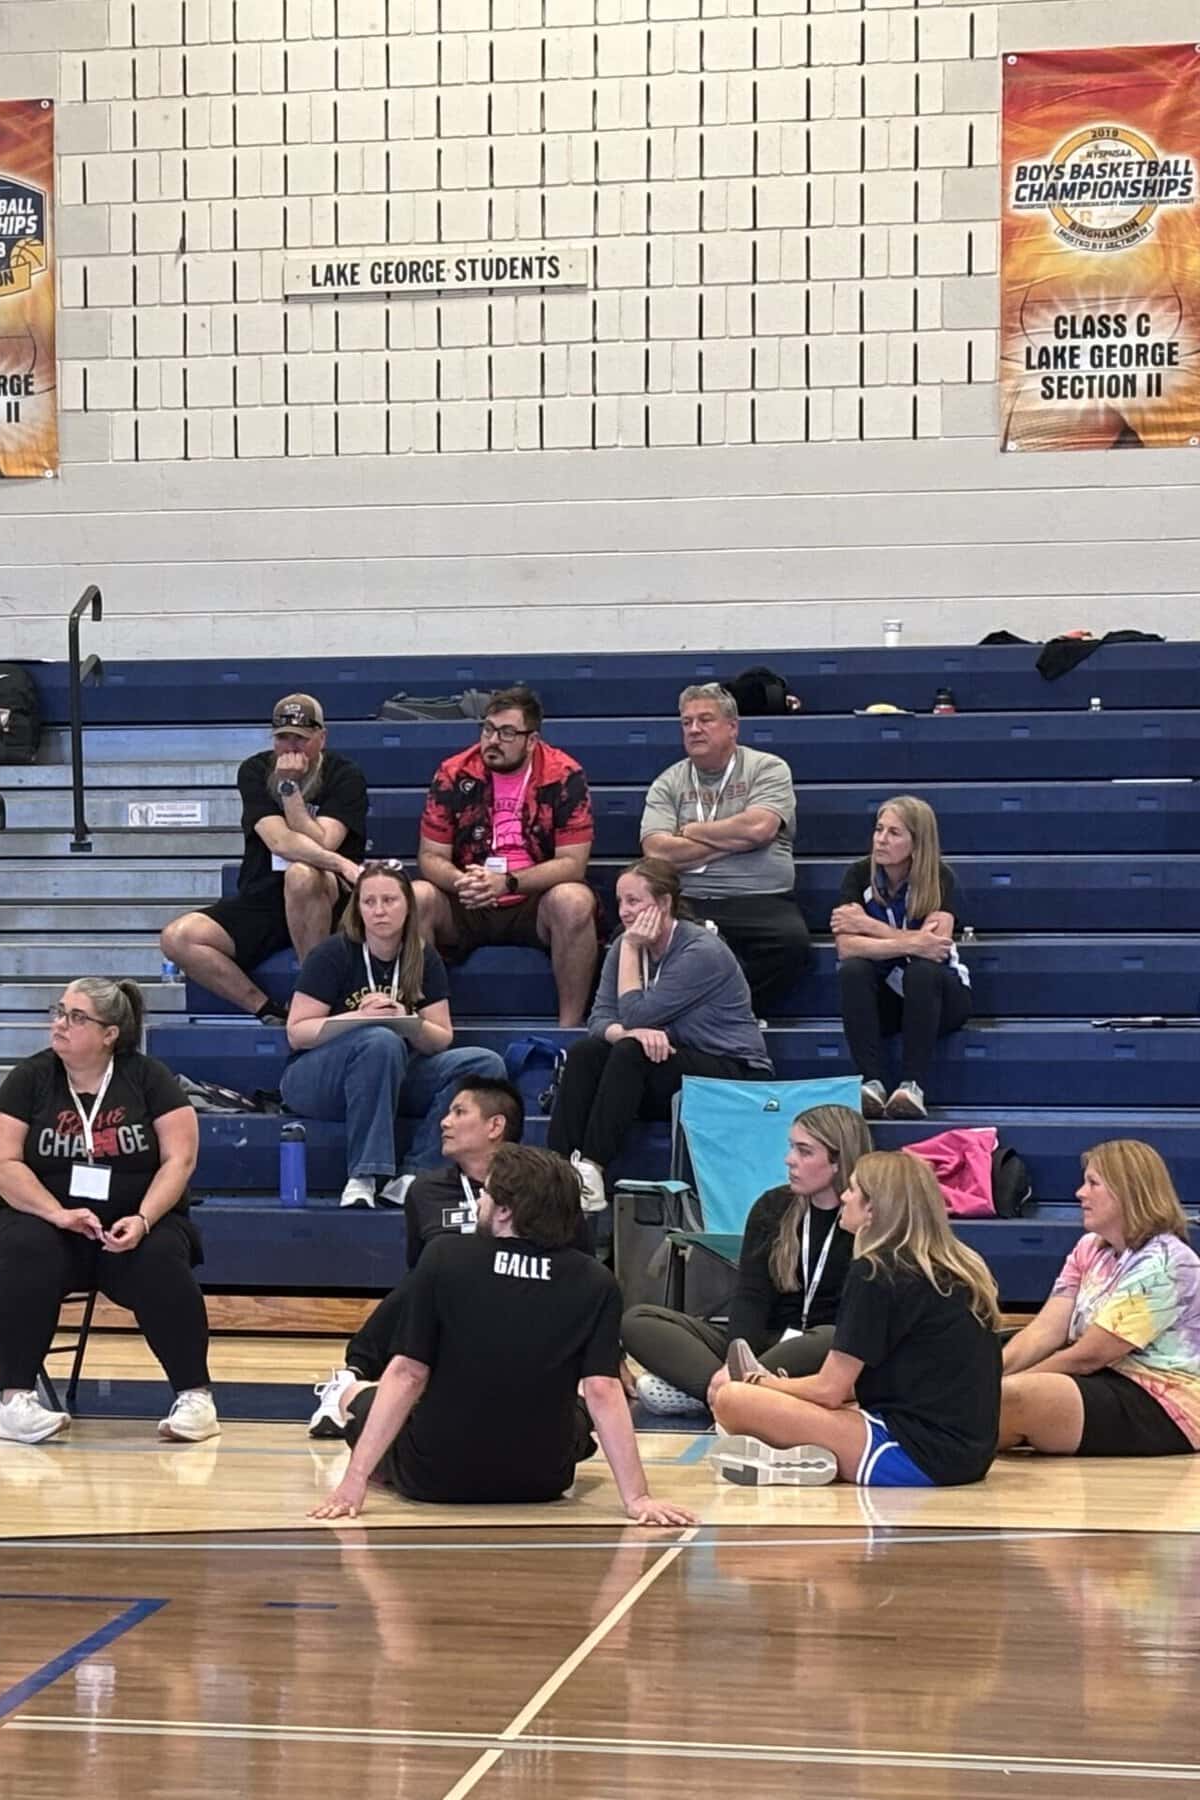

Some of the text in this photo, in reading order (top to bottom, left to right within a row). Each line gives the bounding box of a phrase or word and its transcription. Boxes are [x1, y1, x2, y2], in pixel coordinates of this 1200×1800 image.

[1016, 160, 1193, 182] BOYS BASKETBALL
[1015, 178, 1193, 202] CHAMPIONSHIPS
[1068, 219, 1139, 240] BINGHAMTON
[311, 256, 560, 287] LAKE GEORGE STUDENTS
[1054, 313, 1151, 339] CLASS C
[1025, 343, 1179, 370] LAKE GEORGE
[1041, 373, 1162, 400] SECTION II
[6, 402, 20, 423] II
[494, 1251, 551, 1280] GALLE
